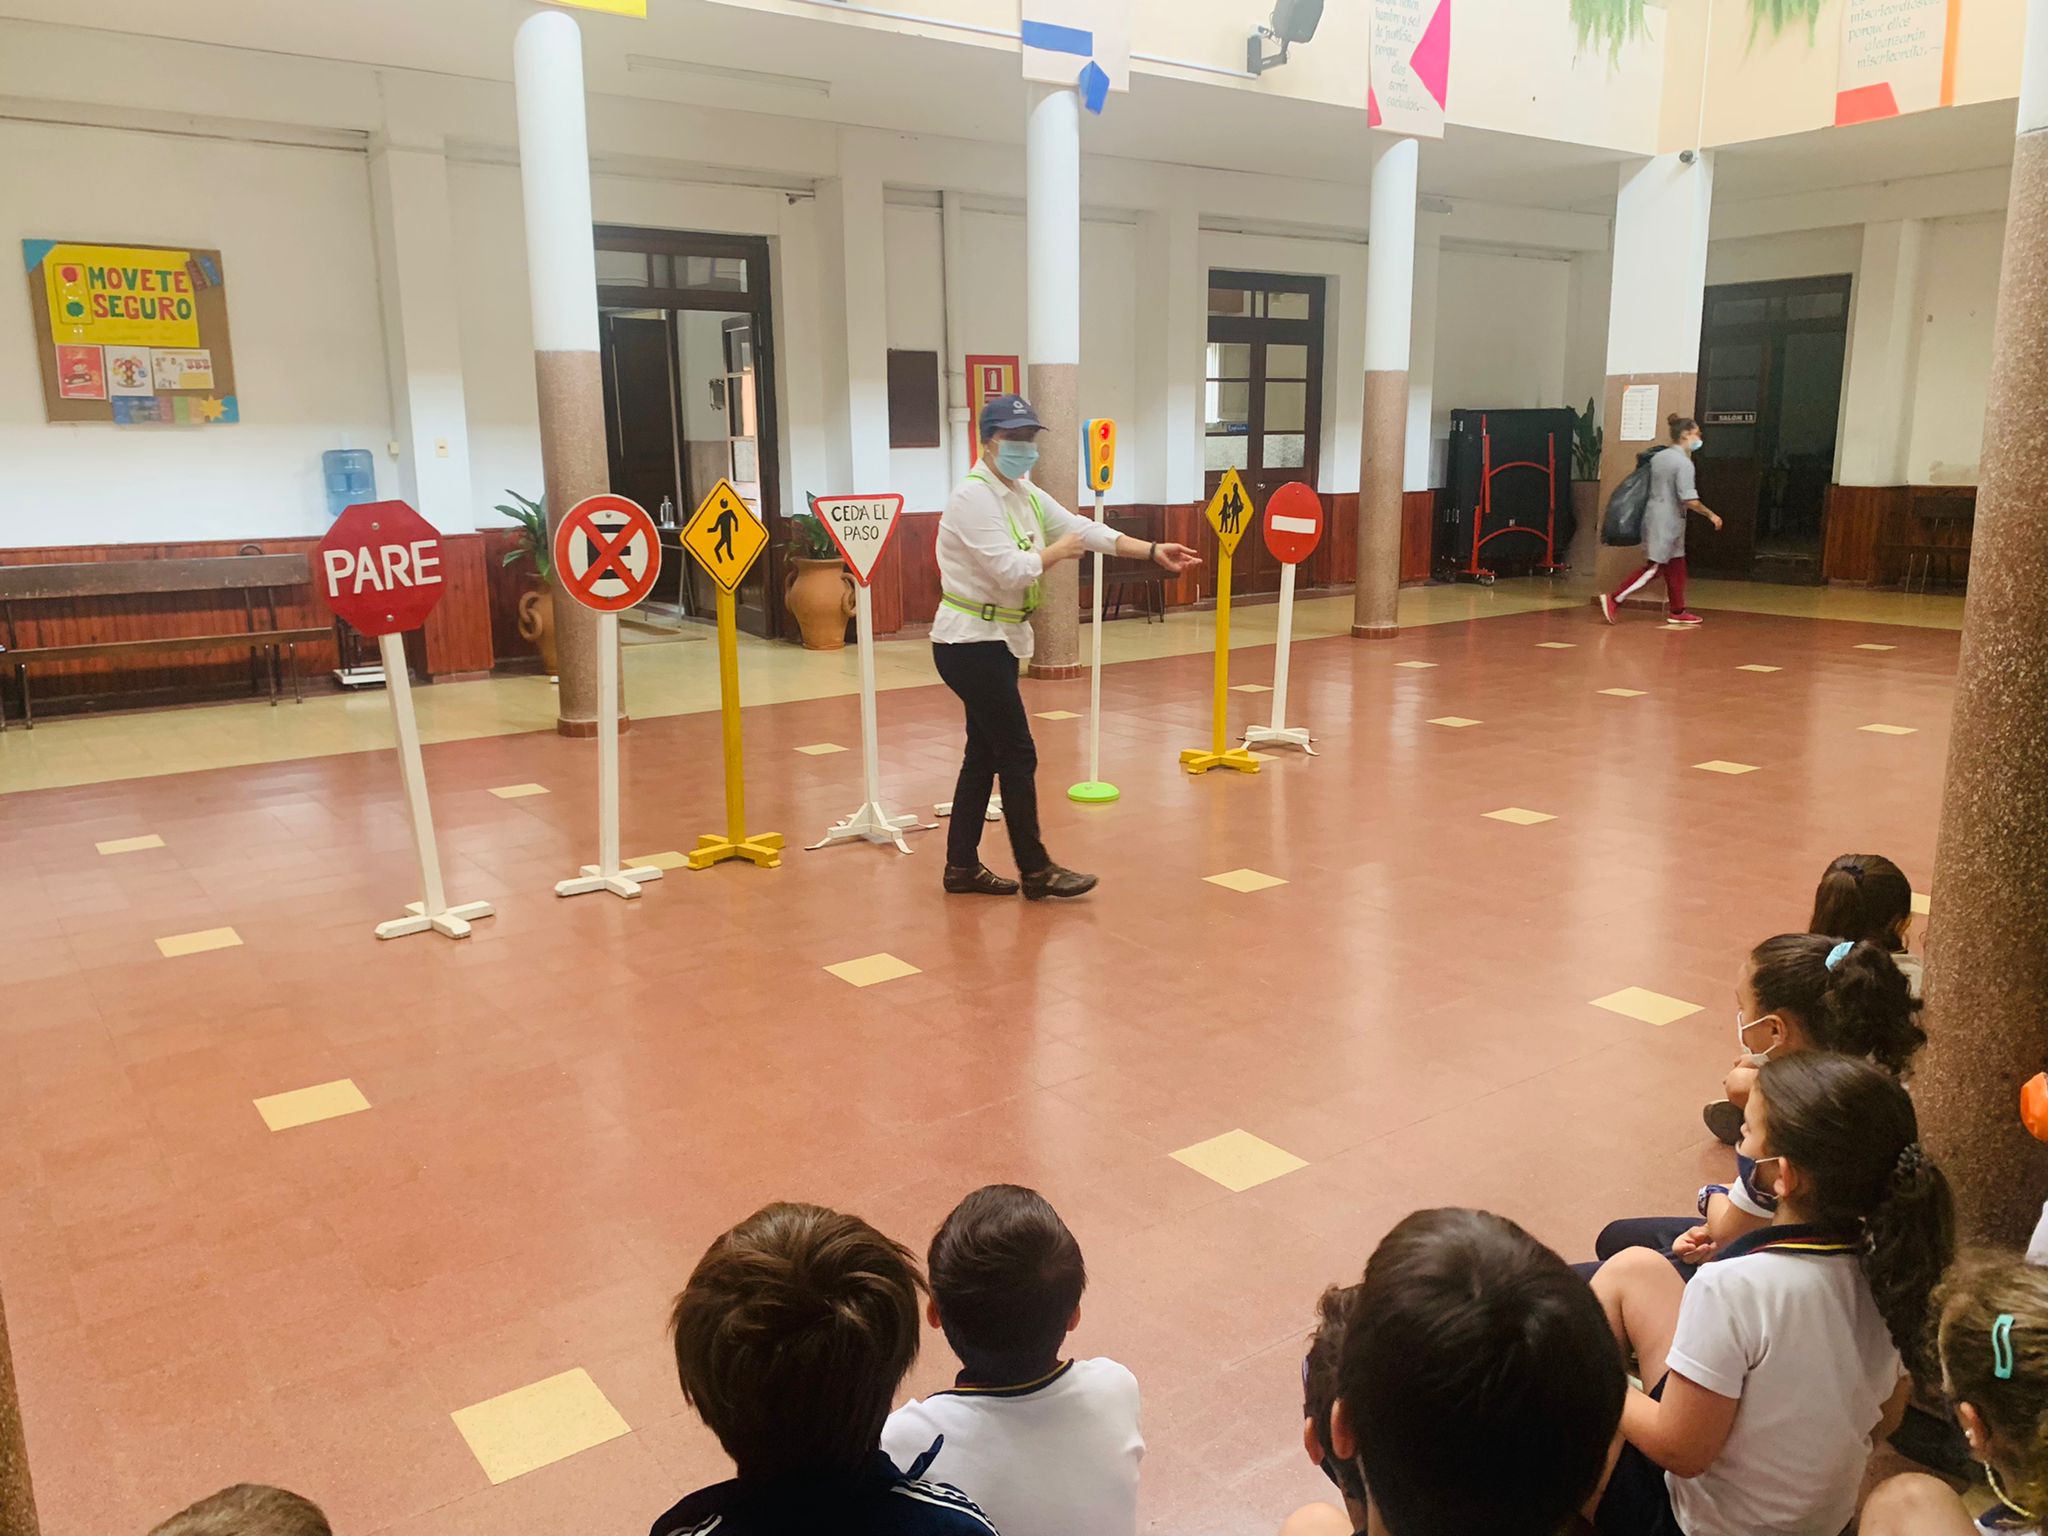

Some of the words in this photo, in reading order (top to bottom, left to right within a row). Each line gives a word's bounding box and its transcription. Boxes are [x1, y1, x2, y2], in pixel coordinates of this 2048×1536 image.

[88, 267, 189, 293] MOVETE
[93, 293, 192, 321] SEGURO
[831, 505, 870, 522] CEDA
[874, 504, 889, 520] EL
[843, 525, 879, 541] PASO
[323, 539, 442, 597] PARE
